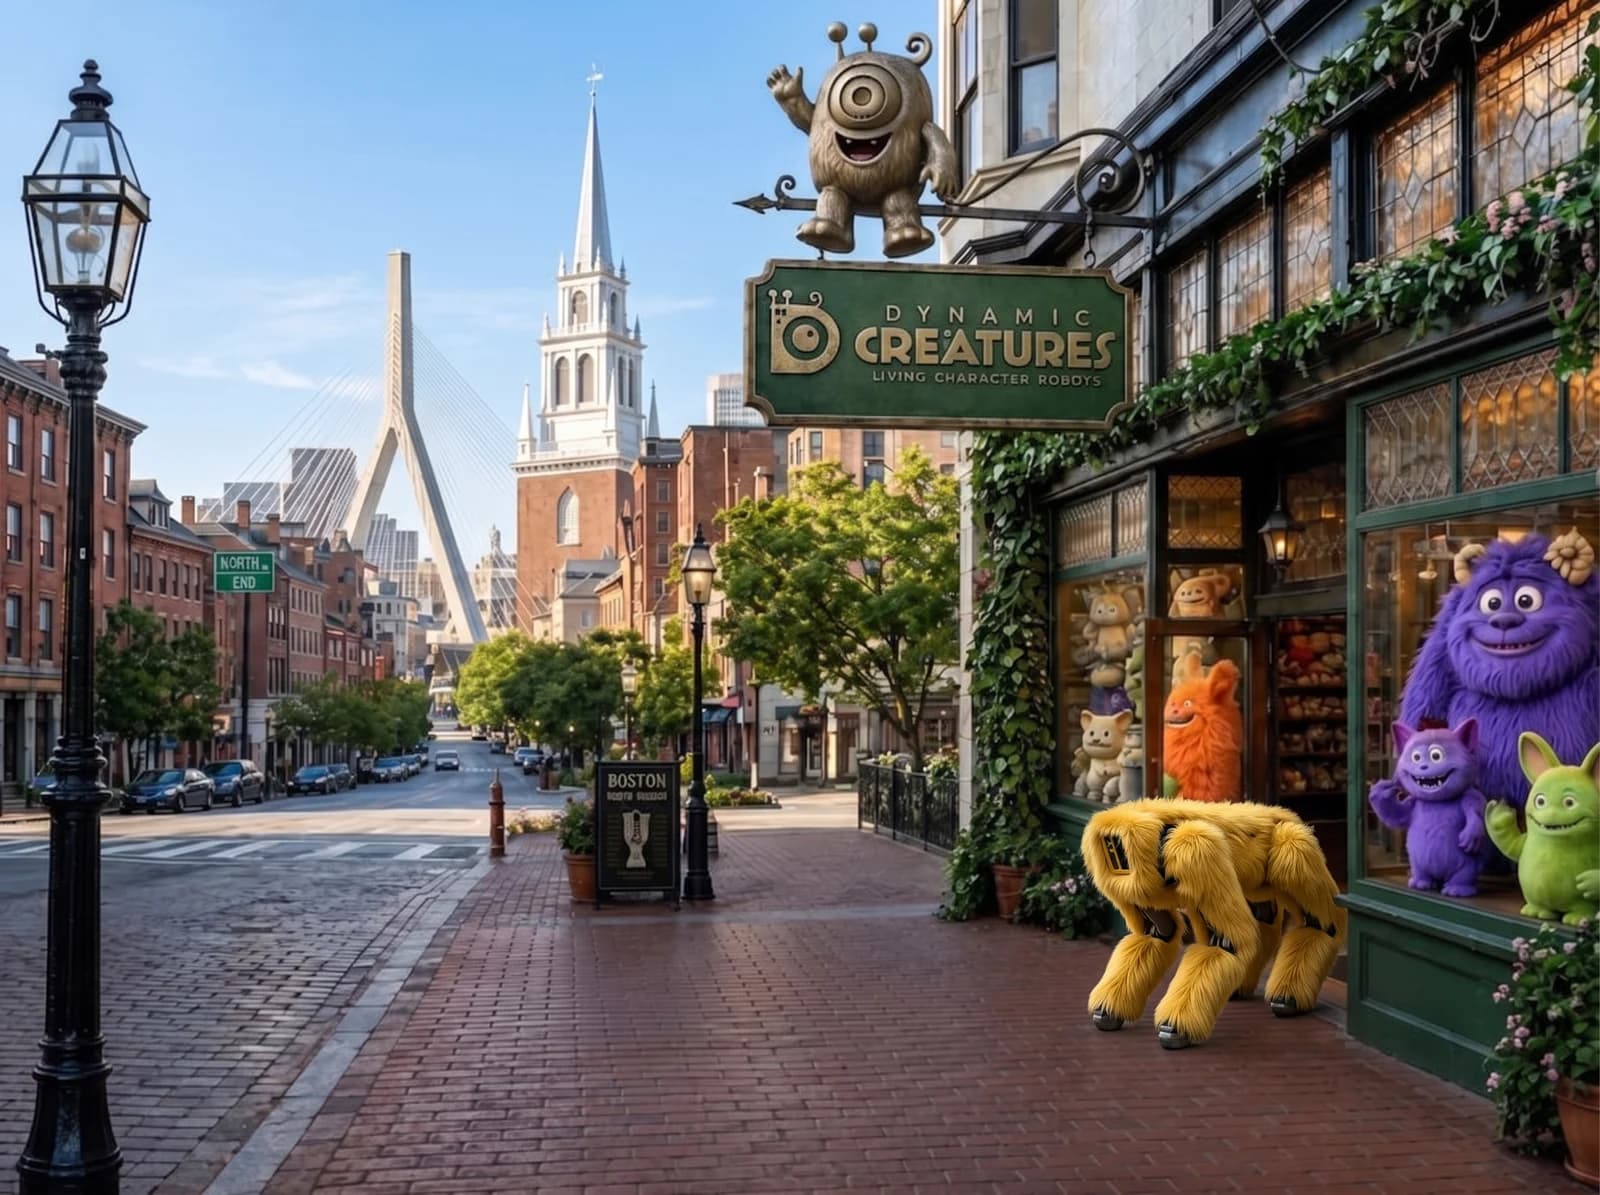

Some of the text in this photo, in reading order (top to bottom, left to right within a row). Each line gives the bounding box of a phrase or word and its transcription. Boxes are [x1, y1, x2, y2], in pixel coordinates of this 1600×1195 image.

[886, 305, 1090, 327] DYNAMIC
[854, 326, 1116, 369] CREATURES
[872, 371, 926, 382] LIVING
[935, 372, 1029, 384] CHARACTER
[220, 556, 260, 570] NORTH
[232, 575, 257, 589] END
[607, 773, 667, 788] BOSTON
